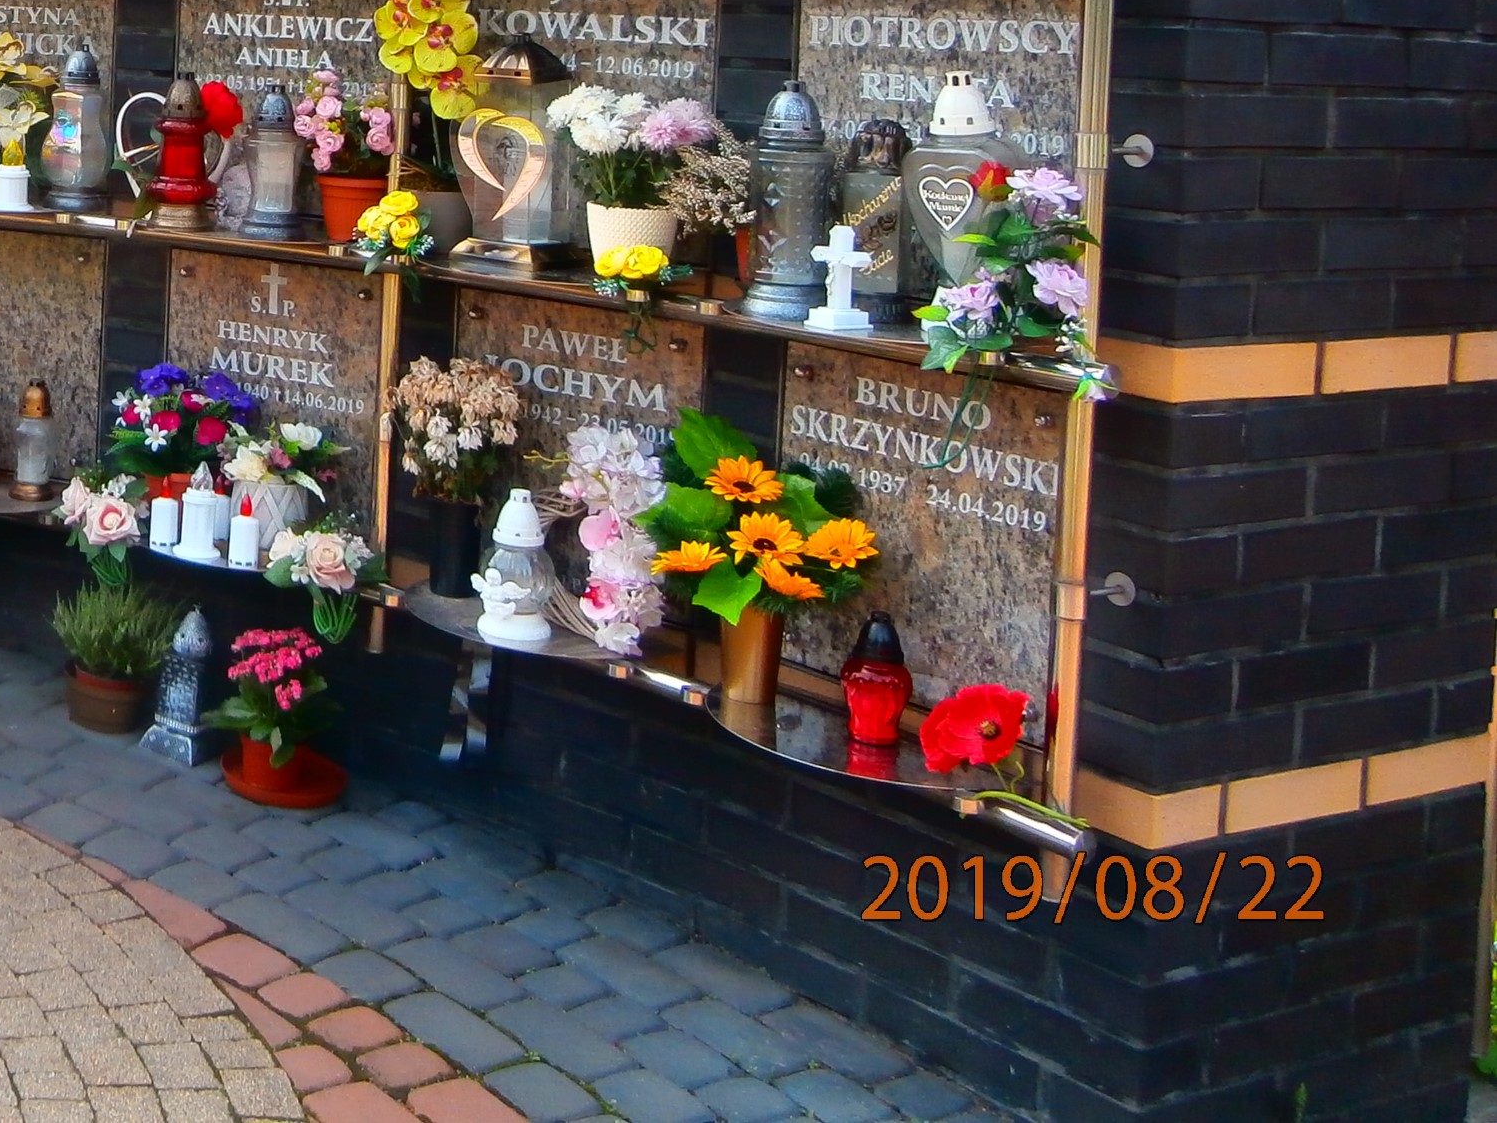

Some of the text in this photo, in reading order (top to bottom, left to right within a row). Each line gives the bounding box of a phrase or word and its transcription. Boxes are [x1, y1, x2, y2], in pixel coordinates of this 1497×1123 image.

[202, 12, 374, 43] ANKLEWICZ
[478, 8, 710, 47] KOWALSKI
[808, 14, 1080, 55] PIOTROWSCY
[234, 46, 335, 70] ANIELA
[595, 54, 696, 80] 12.06.2019
[217, 318, 330, 354] HENRYK
[522, 323, 628, 365] PAWEŁ
[209, 347, 335, 389] MUREK
[284, 390, 365, 415] 14.06.2019
[854, 376, 992, 430] BRUNO
[926, 483, 1048, 533] 24.04.2019
